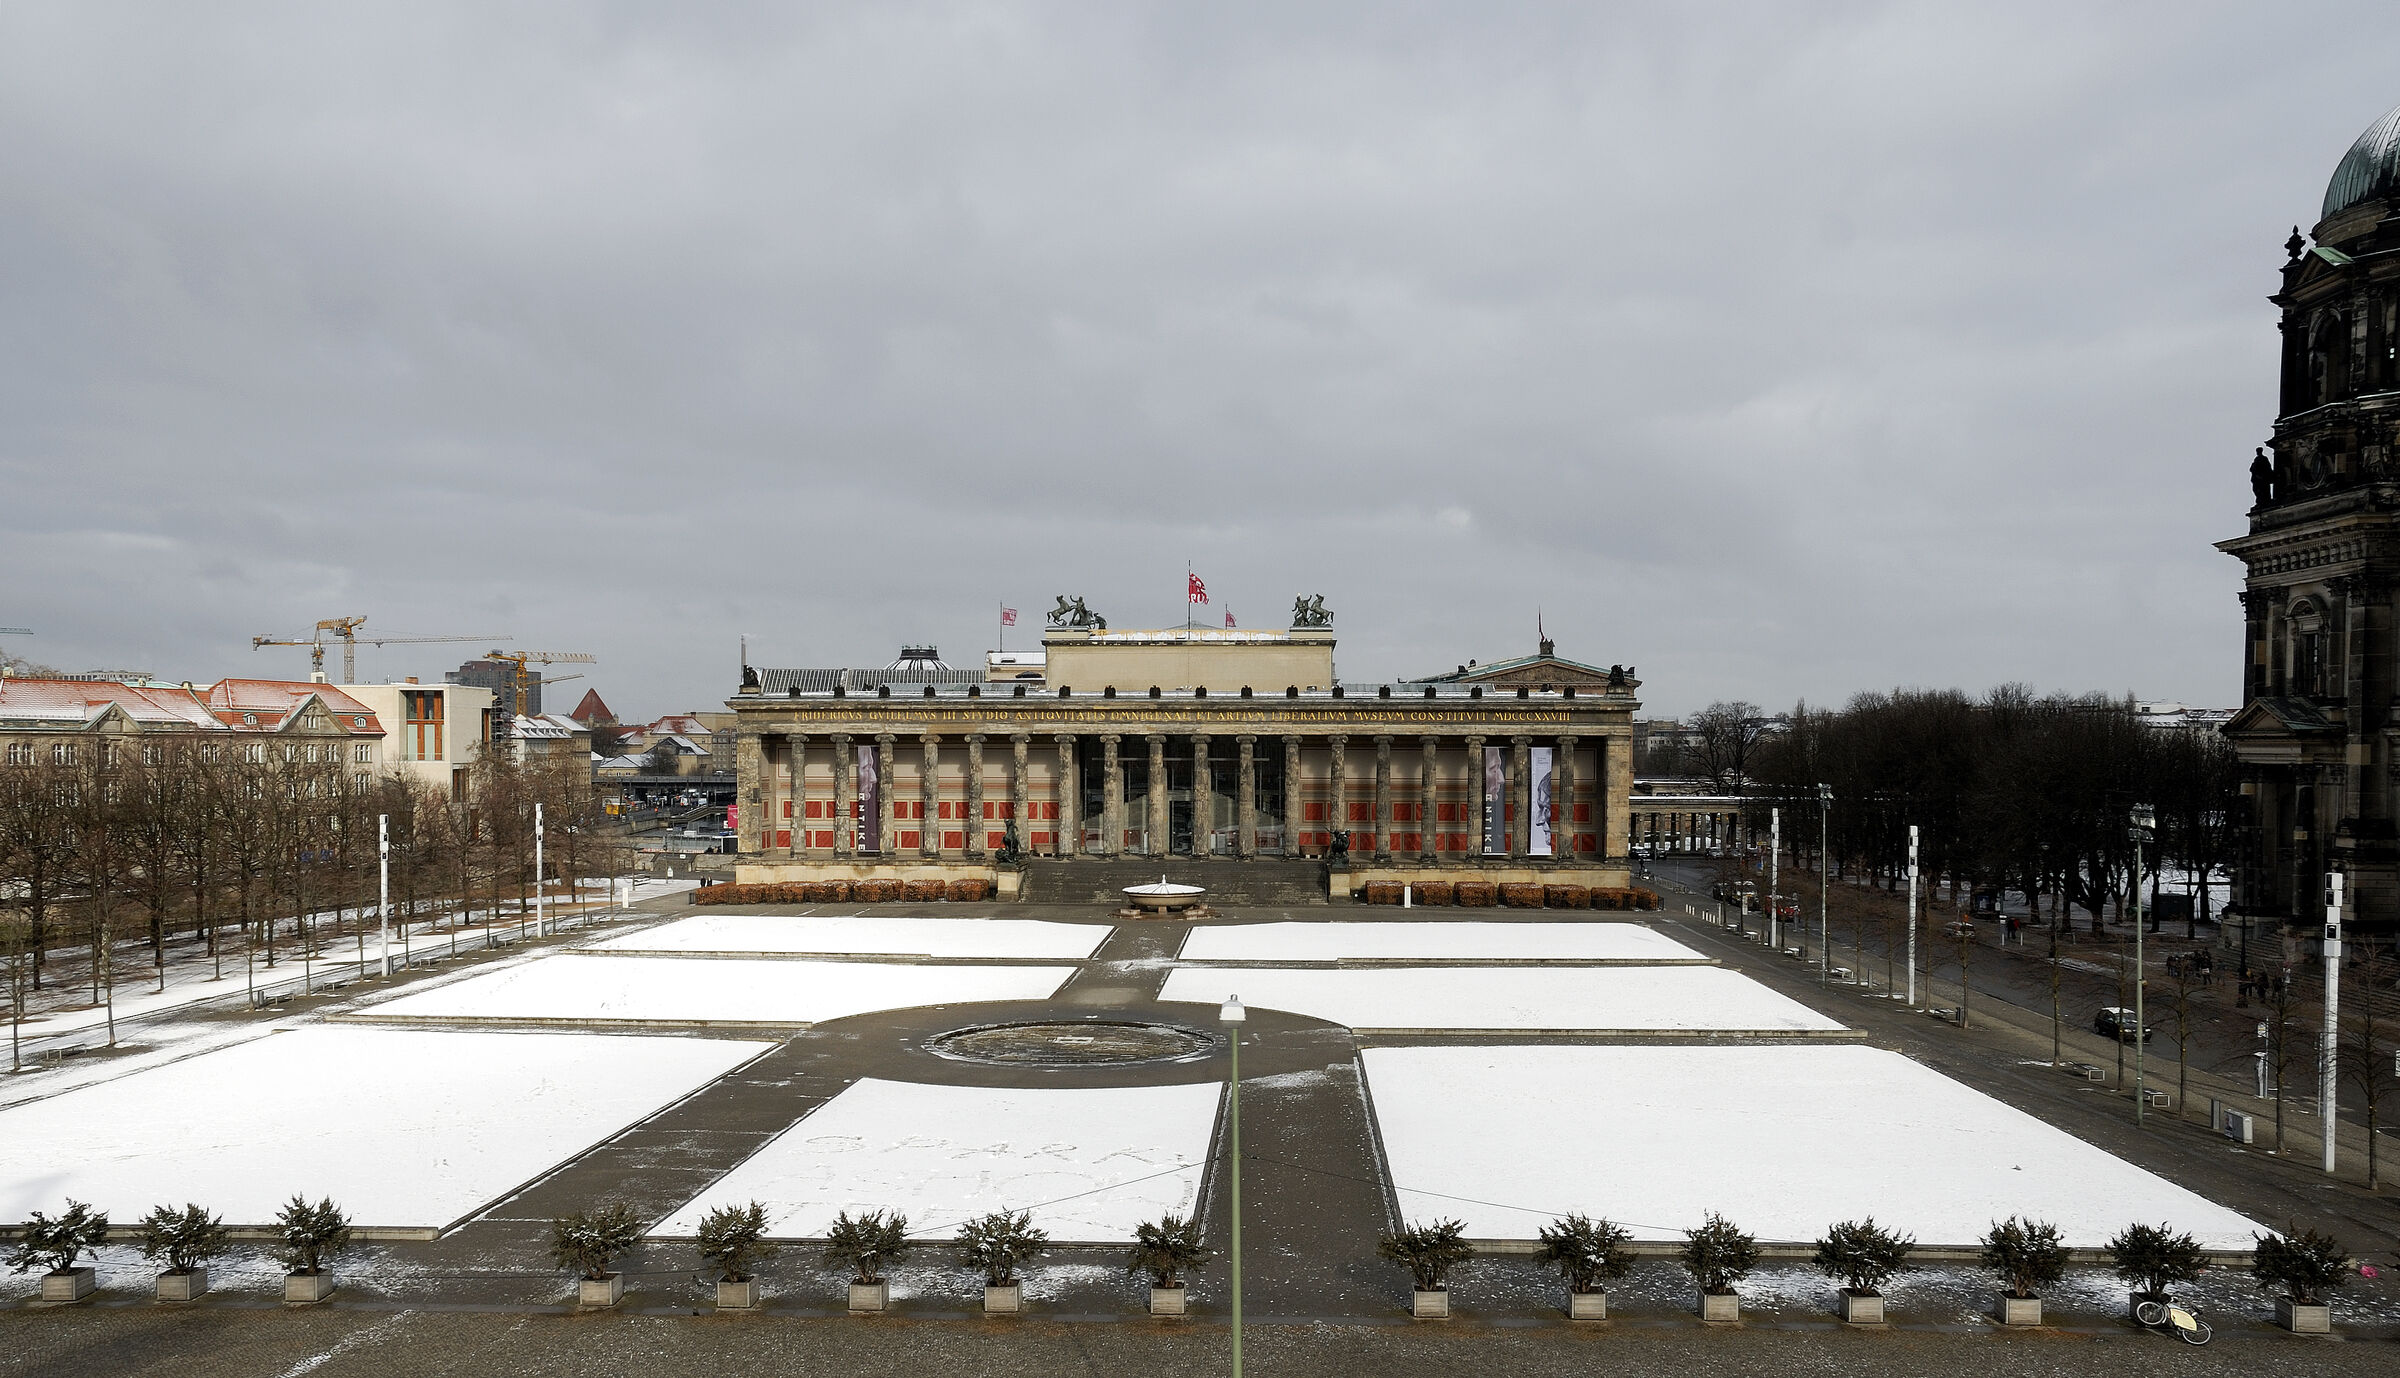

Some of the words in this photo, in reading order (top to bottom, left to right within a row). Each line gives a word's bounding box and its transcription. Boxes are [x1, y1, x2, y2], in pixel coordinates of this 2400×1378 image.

[794, 711, 863, 721] FRIDERICVS
[942, 711, 957, 721] III
[962, 711, 1009, 721] STVDIO
[1014, 711, 1107, 721] ANTIQVITATIS
[1111, 711, 1191, 721] OMNIGENAE
[1197, 711, 1212, 721] ET
[1216, 711, 1266, 721] ARTIVM
[1271, 711, 1347, 721] LIBERALIVM
[1353, 711, 1405, 721] MVSEVM
[1410, 711, 1488, 721] CONSTITVIT
[1492, 711, 1571, 721] MDCCCXXVIII
[858, 792, 866, 851] ANTIKE
[1484, 793, 1493, 853] ANTIKE
